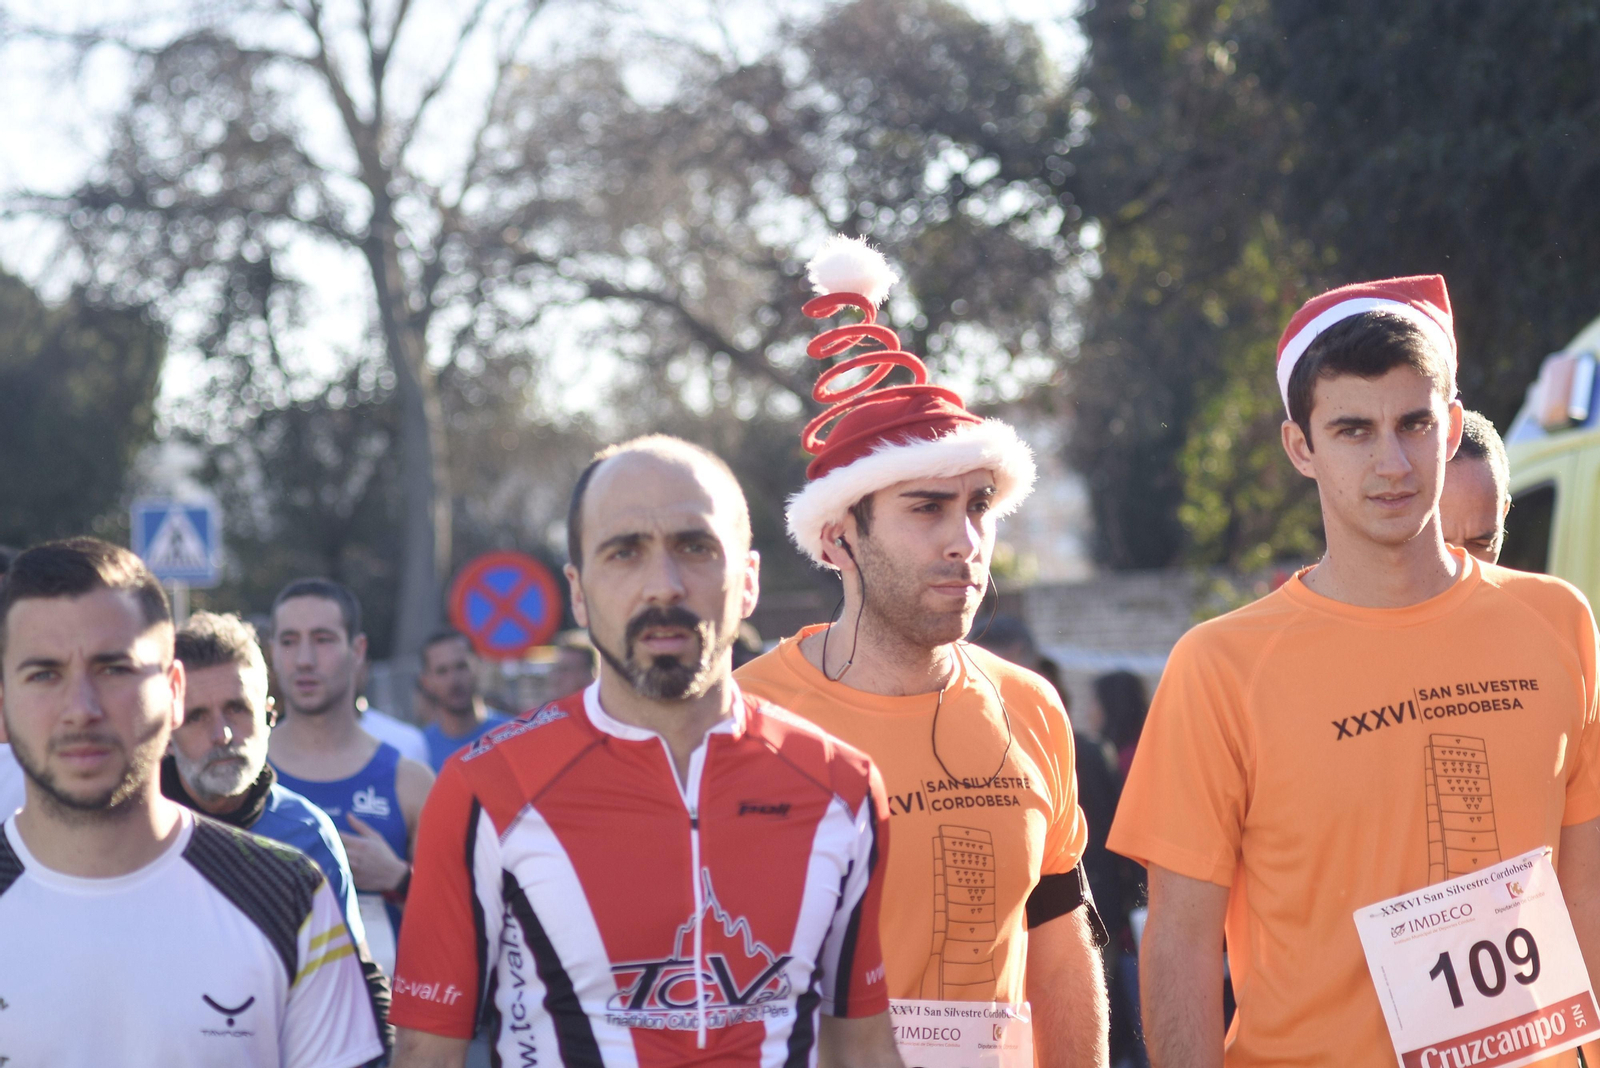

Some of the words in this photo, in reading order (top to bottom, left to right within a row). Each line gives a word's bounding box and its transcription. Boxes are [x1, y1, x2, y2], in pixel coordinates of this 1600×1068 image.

[1419, 686, 1452, 701] SAN
[1456, 679, 1539, 696] SILVESTRE
[1331, 700, 1417, 741] XXXVI
[1423, 698, 1524, 720] CORDOBESA
[926, 780, 959, 793] SAN
[931, 795, 1021, 812] CORDOBESA
[1381, 897, 1422, 917] XXXVI
[1423, 891, 1445, 904] San
[1446, 877, 1490, 897] Silvestre
[1490, 861, 1534, 883] Cordobesa
[1408, 903, 1473, 933] IMDECO
[1429, 927, 1541, 1009] 109
[923, 1006, 942, 1017] San
[944, 1007, 982, 1018] Silvestre
[1571, 1004, 1587, 1028] SIN
[901, 1026, 961, 1042] IMDECO
[1420, 1012, 1566, 1068] Cruzcampo
